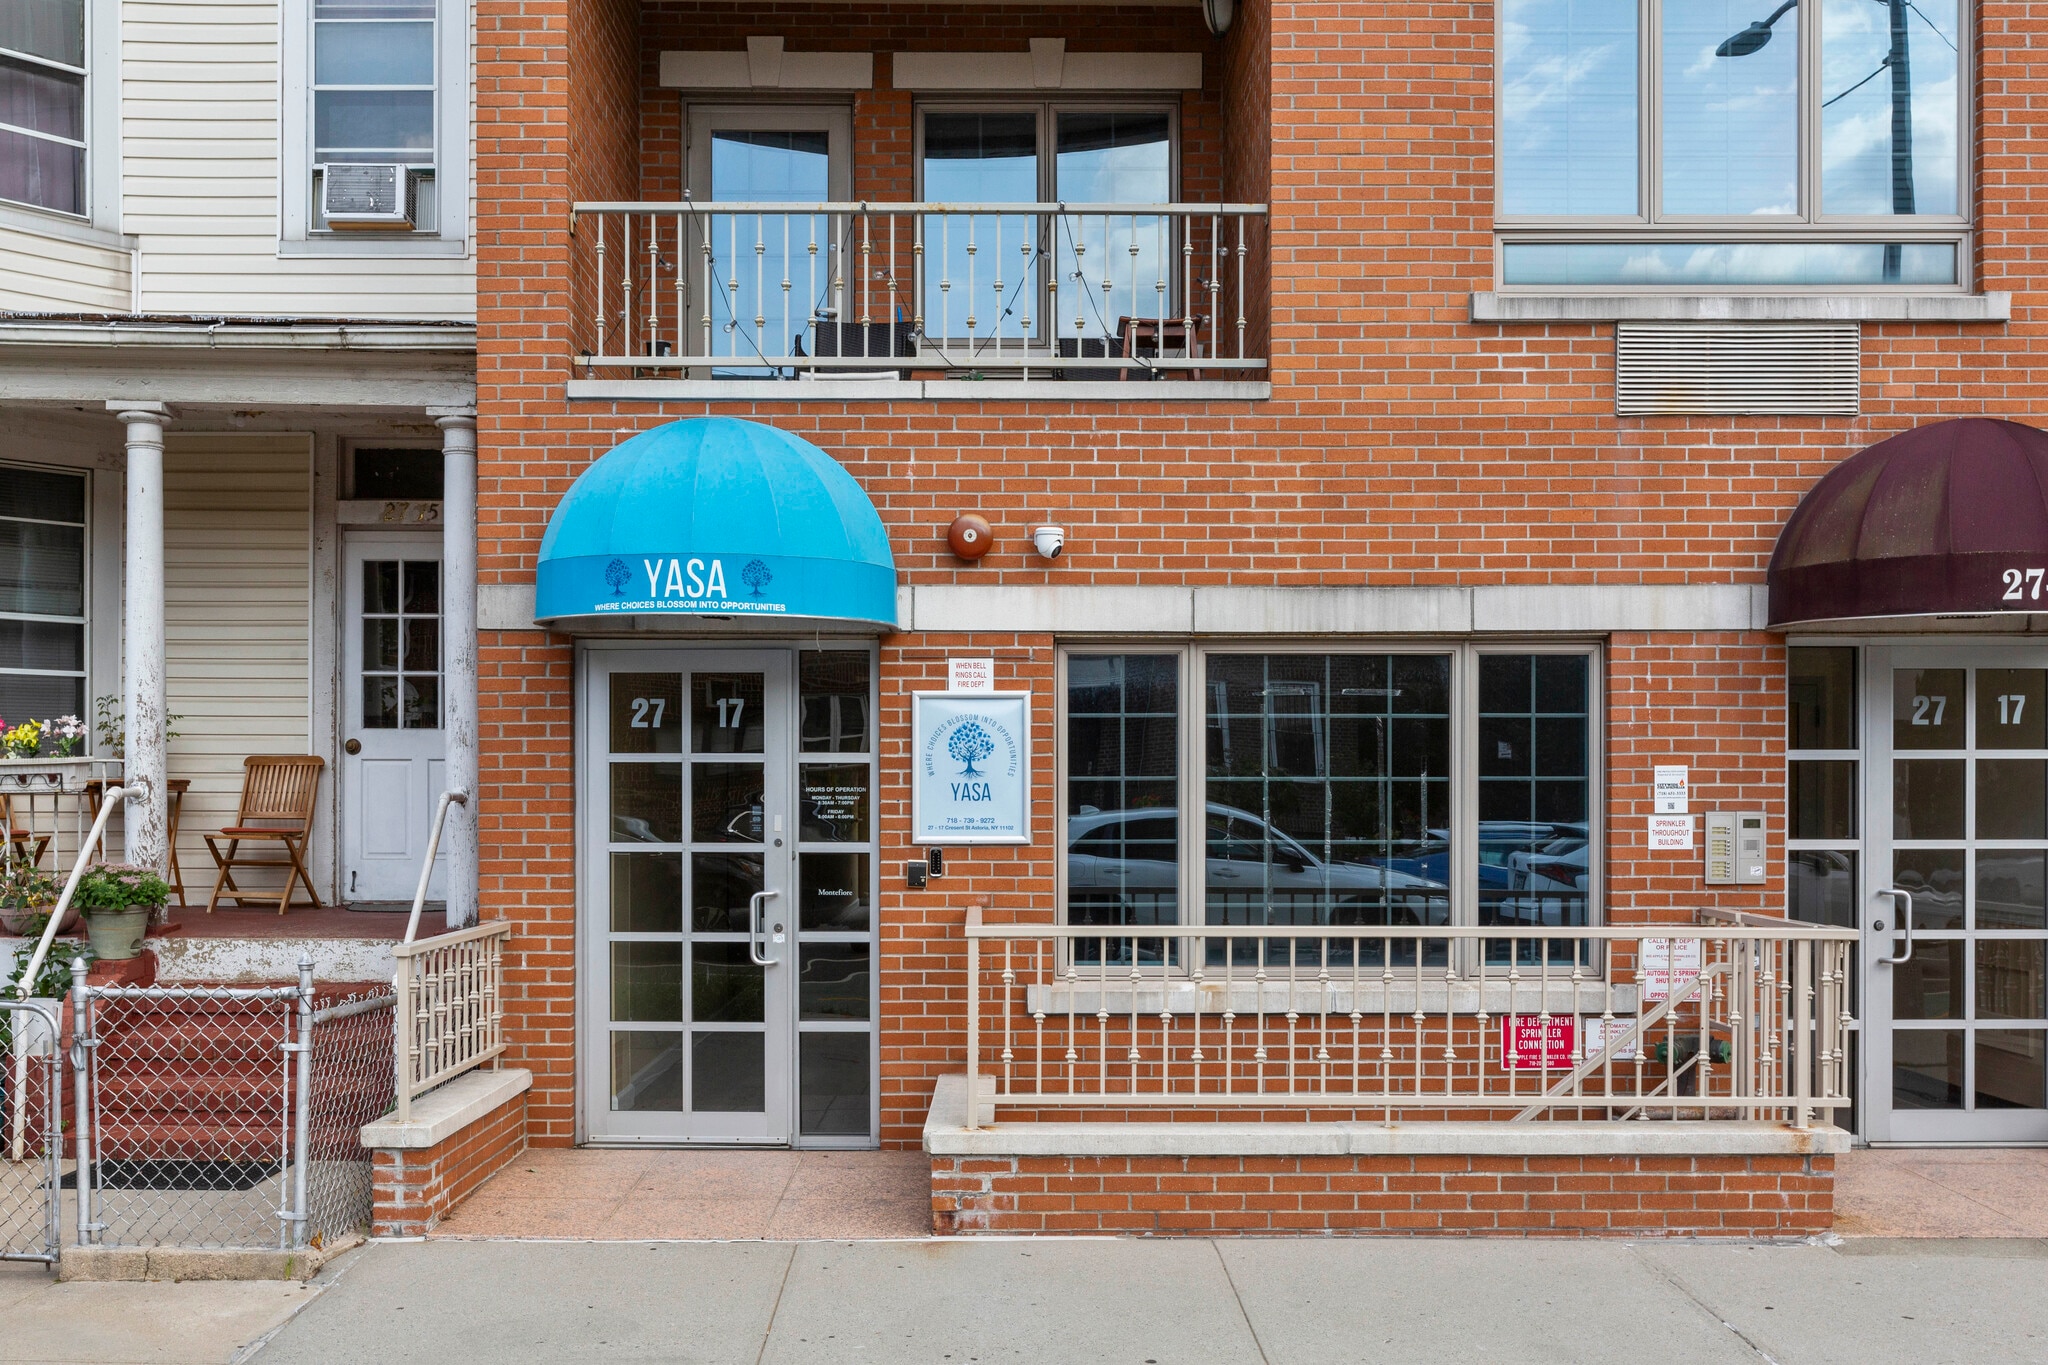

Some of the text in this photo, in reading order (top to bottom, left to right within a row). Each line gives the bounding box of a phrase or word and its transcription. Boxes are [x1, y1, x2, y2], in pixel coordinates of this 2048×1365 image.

[644, 558, 728, 599] YASA
[2002, 568, 2048, 601] 27
[595, 600, 786, 612] WHERE CHOICES BLOSSOM INTO OPPORTUNITIES
[631, 697, 744, 728] 27 17
[1911, 694, 2026, 725] 27 17
[926, 714, 1017, 778] WHERE CHOICES BLOSSOM INTO OPPORTUNITIES
[950, 782, 992, 801] YASA
[818, 888, 853, 896] Montefiore
[1509, 1017, 1573, 1026] RE DEPTMENT
[1521, 1028, 1561, 1038] SPRINLER
[1518, 1040, 1564, 1049] CONNETION
